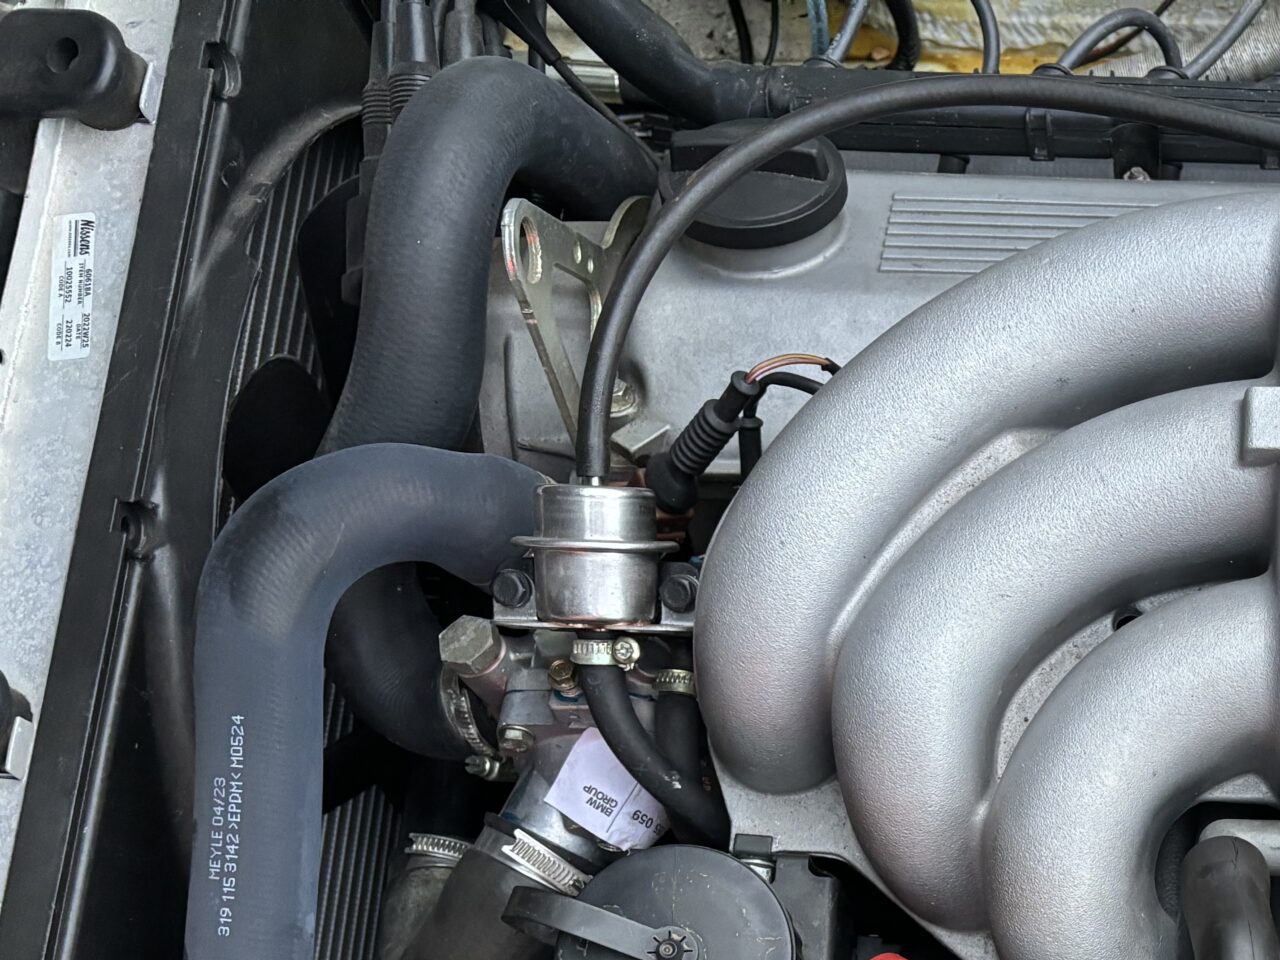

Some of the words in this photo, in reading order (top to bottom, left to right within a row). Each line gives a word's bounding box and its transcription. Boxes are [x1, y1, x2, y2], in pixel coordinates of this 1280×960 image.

[79, 219, 96, 256] Nissens
[65, 267, 73, 304] 10025552
[84, 268, 93, 297] 60618A
[65, 319, 73, 348] 220224
[82, 313, 91, 349] 2022W25
[212, 776, 226, 827] 04/23
[582, 784, 619, 809] GROUP
[586, 796, 614, 818] BMW
[631, 809, 654, 829] 059
[209, 829, 223, 880] MEYLE
[224, 833, 240, 873] 3142
[222, 876, 236, 902] 115
[218, 907, 232, 937] 319
